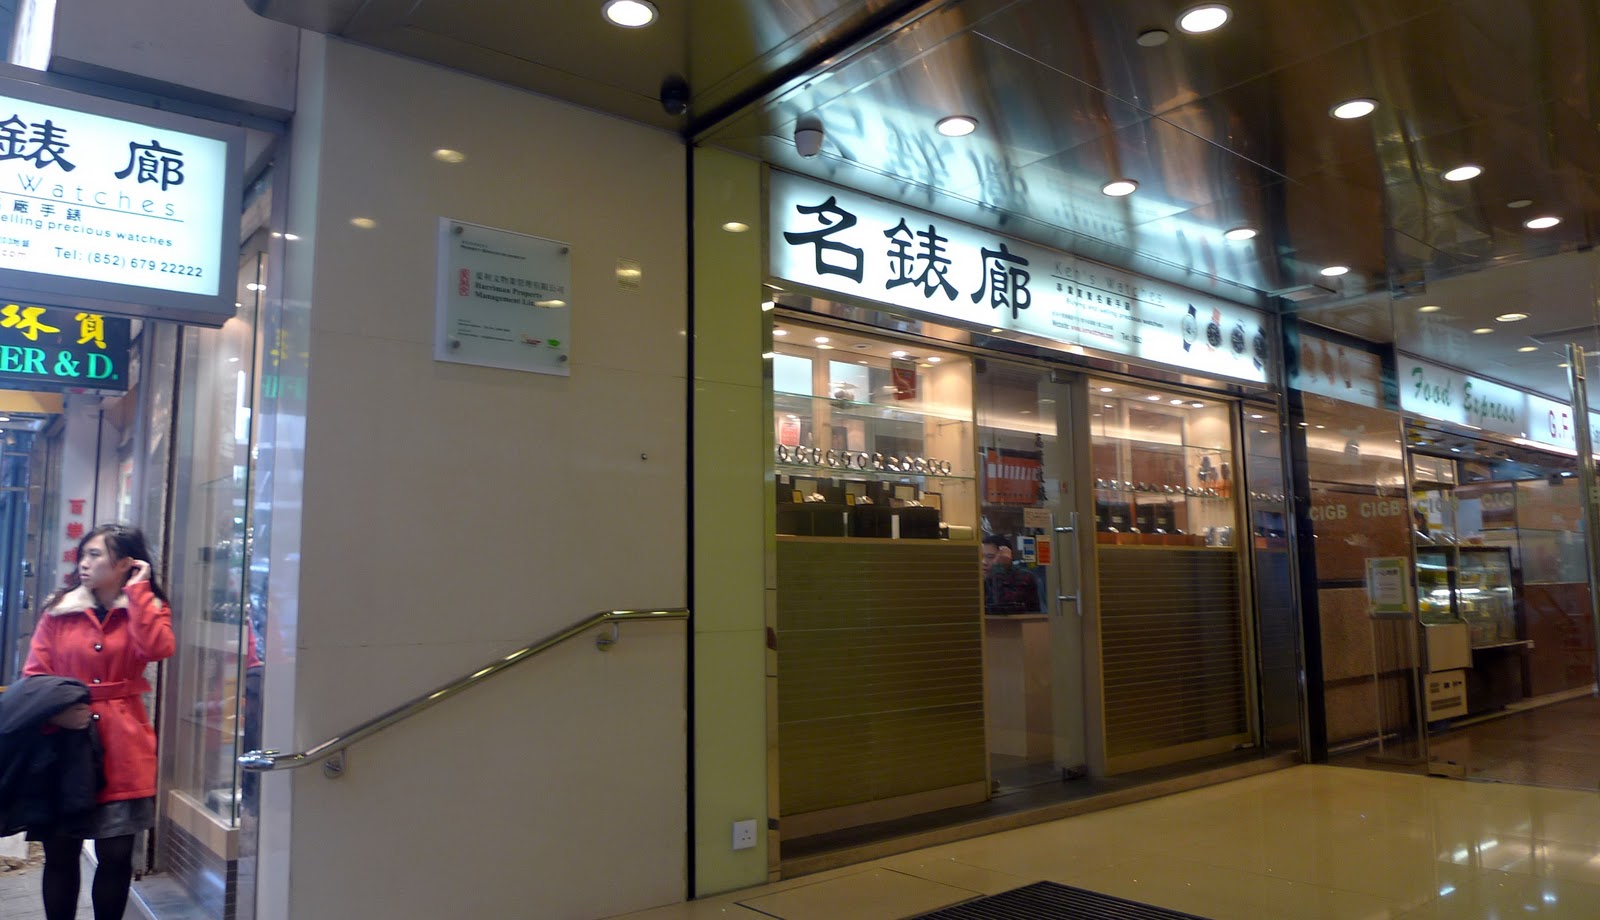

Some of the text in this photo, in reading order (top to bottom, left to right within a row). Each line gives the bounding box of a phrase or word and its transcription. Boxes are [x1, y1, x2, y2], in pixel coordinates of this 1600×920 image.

[0, 198, 81, 221] 廠手錶
[18, 174, 176, 217] Watches
[48, 221, 112, 238] precious
[116, 232, 173, 247] watches
[55, 246, 204, 278] Tel: (852) 679 22222
[783, 196, 1031, 320] 名錶廊
[54, 350, 80, 377] &
[86, 353, 119, 380] D.
[1411, 366, 1516, 424] Food Express
[1309, 504, 1348, 522] CIGB
[1360, 499, 1403, 518] CIGB
